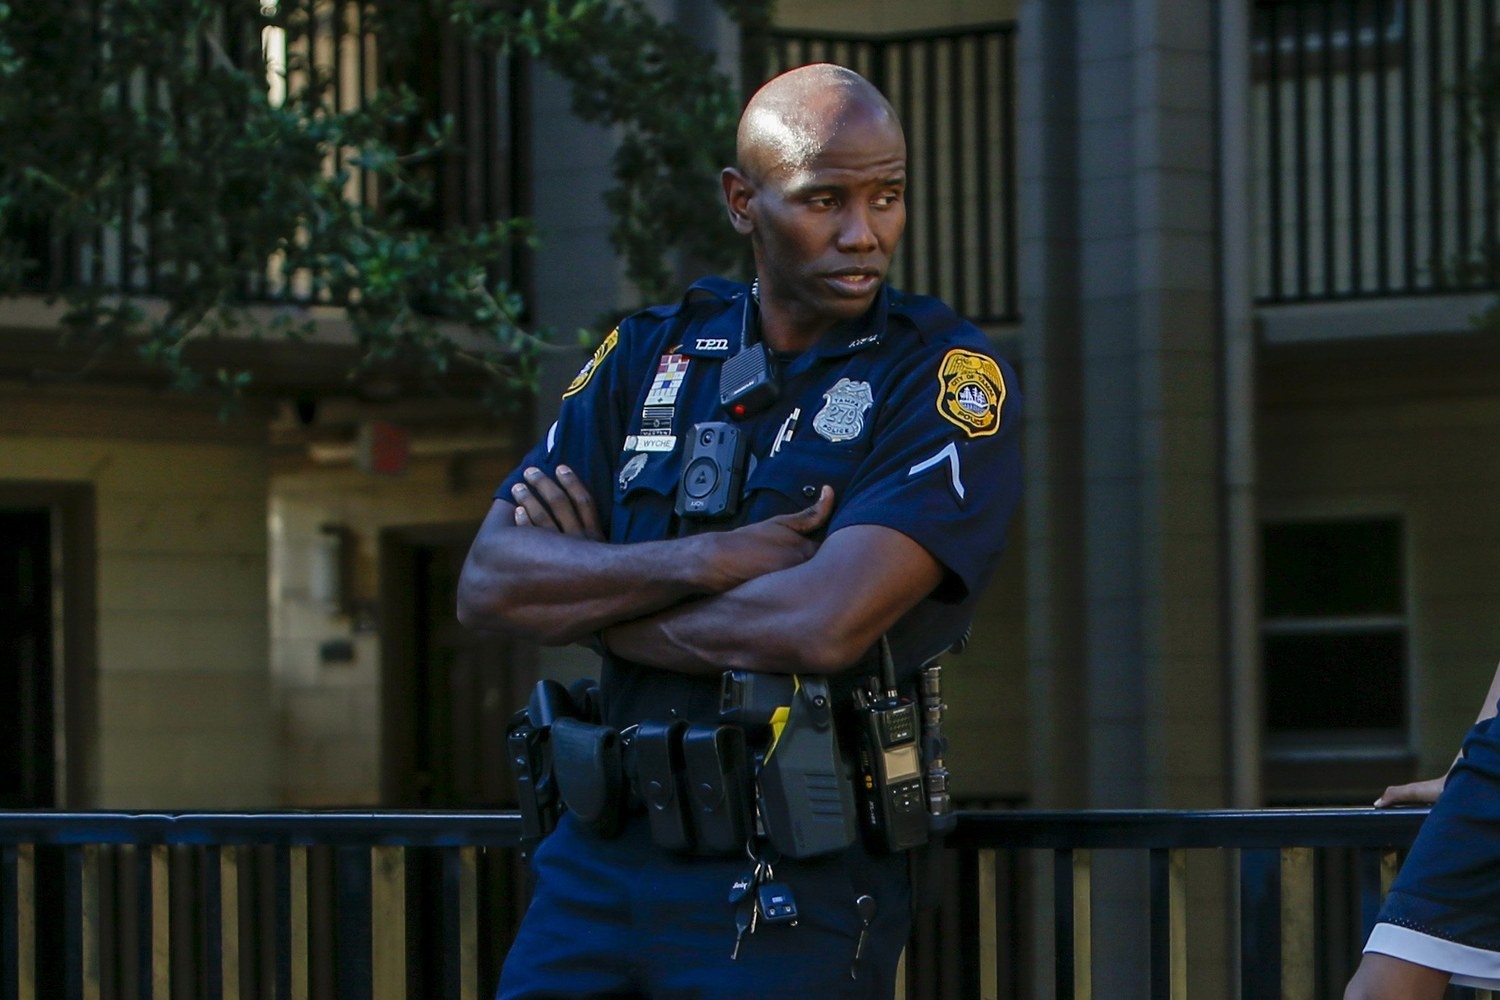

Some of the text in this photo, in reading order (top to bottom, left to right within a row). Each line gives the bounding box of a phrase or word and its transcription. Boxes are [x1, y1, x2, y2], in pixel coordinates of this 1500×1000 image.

[950, 376, 963, 387] CITY
[978, 376, 995, 398] TAMPA
[834, 398, 859, 407] TAMPA
[825, 406, 857, 425] 279
[958, 410, 985, 426] POLICE
[822, 424, 850, 434] POLICE
[643, 439, 671, 448] WYCHE
